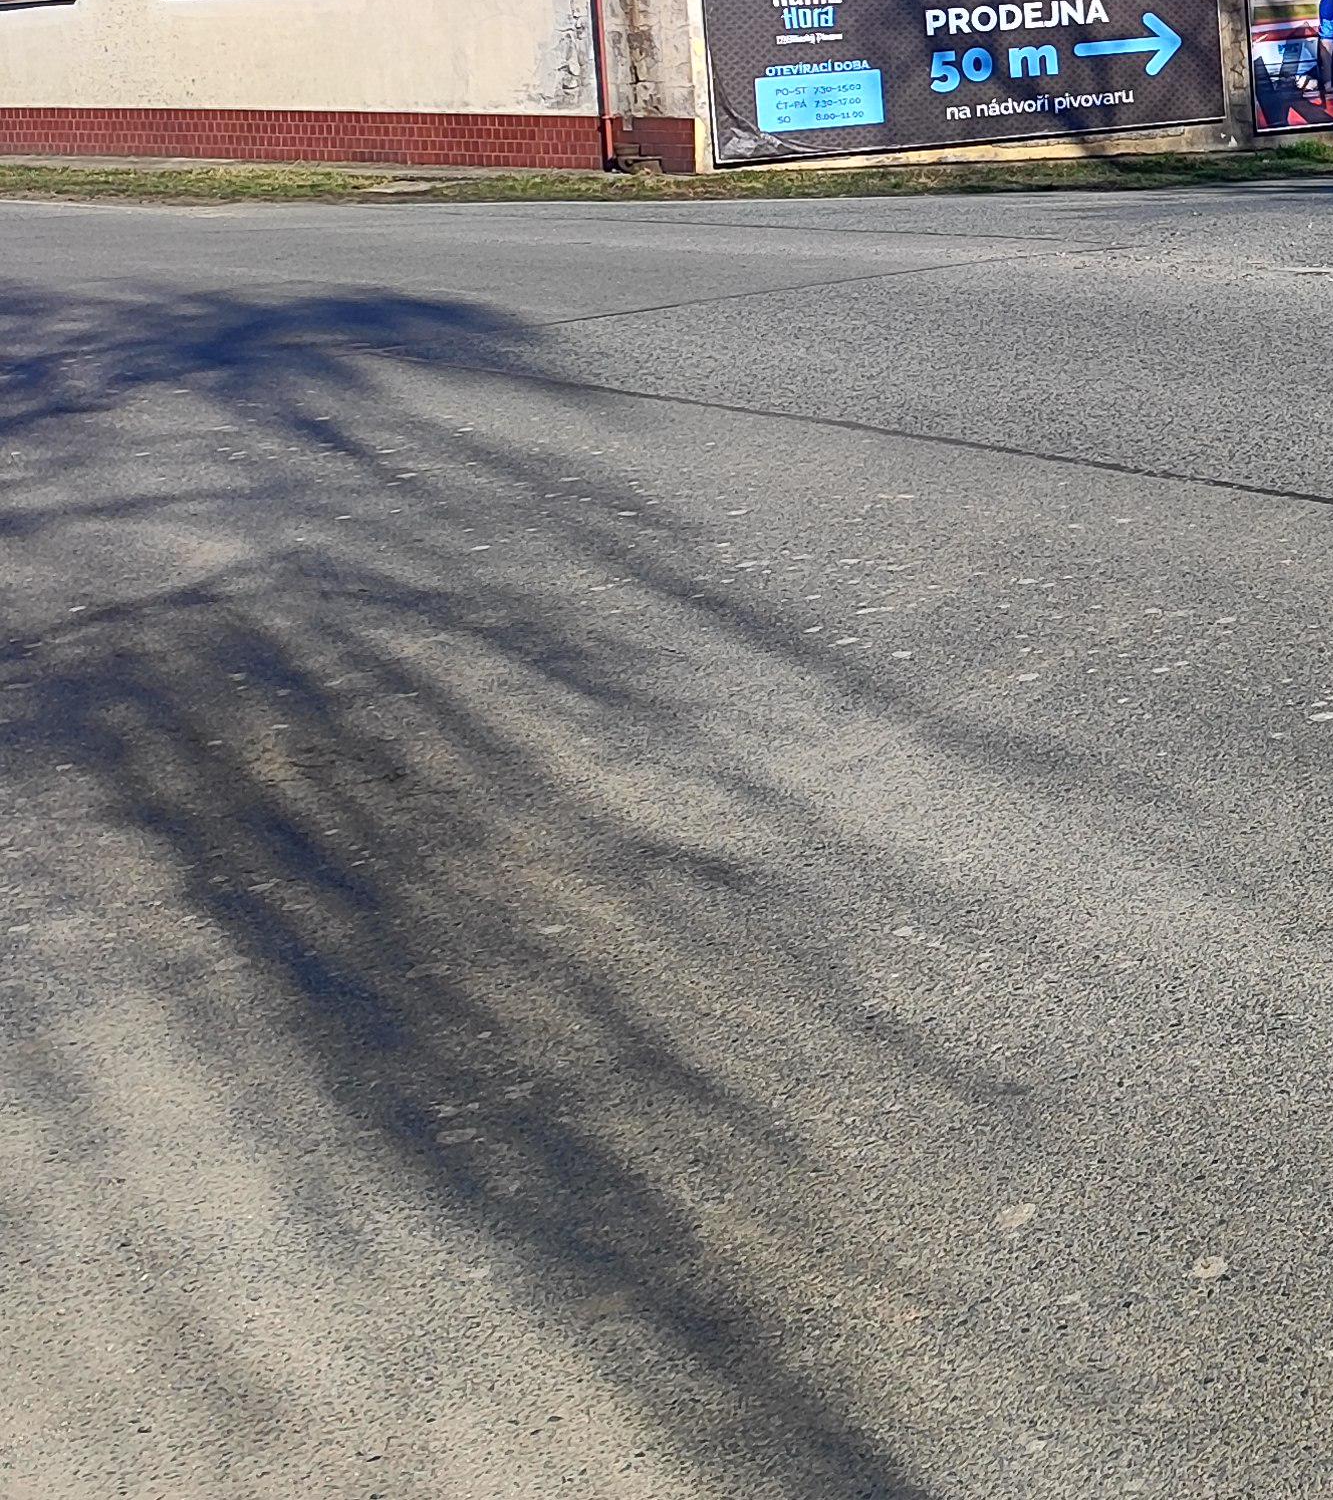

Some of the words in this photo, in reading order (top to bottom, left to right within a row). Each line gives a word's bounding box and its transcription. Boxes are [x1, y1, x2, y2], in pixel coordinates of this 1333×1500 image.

[780, 5, 835, 30] Hora
[765, 58, 832, 77] OTEVÍRACÍ
[833, 59, 871, 72] DOBA
[930, 49, 993, 94] 50
[1008, 42, 1059, 78] m
[946, 102, 971, 121] na
[976, 94, 1050, 118] nádvoří
[1054, 87, 1135, 117] pivovaru
[777, 115, 792, 125] SO
